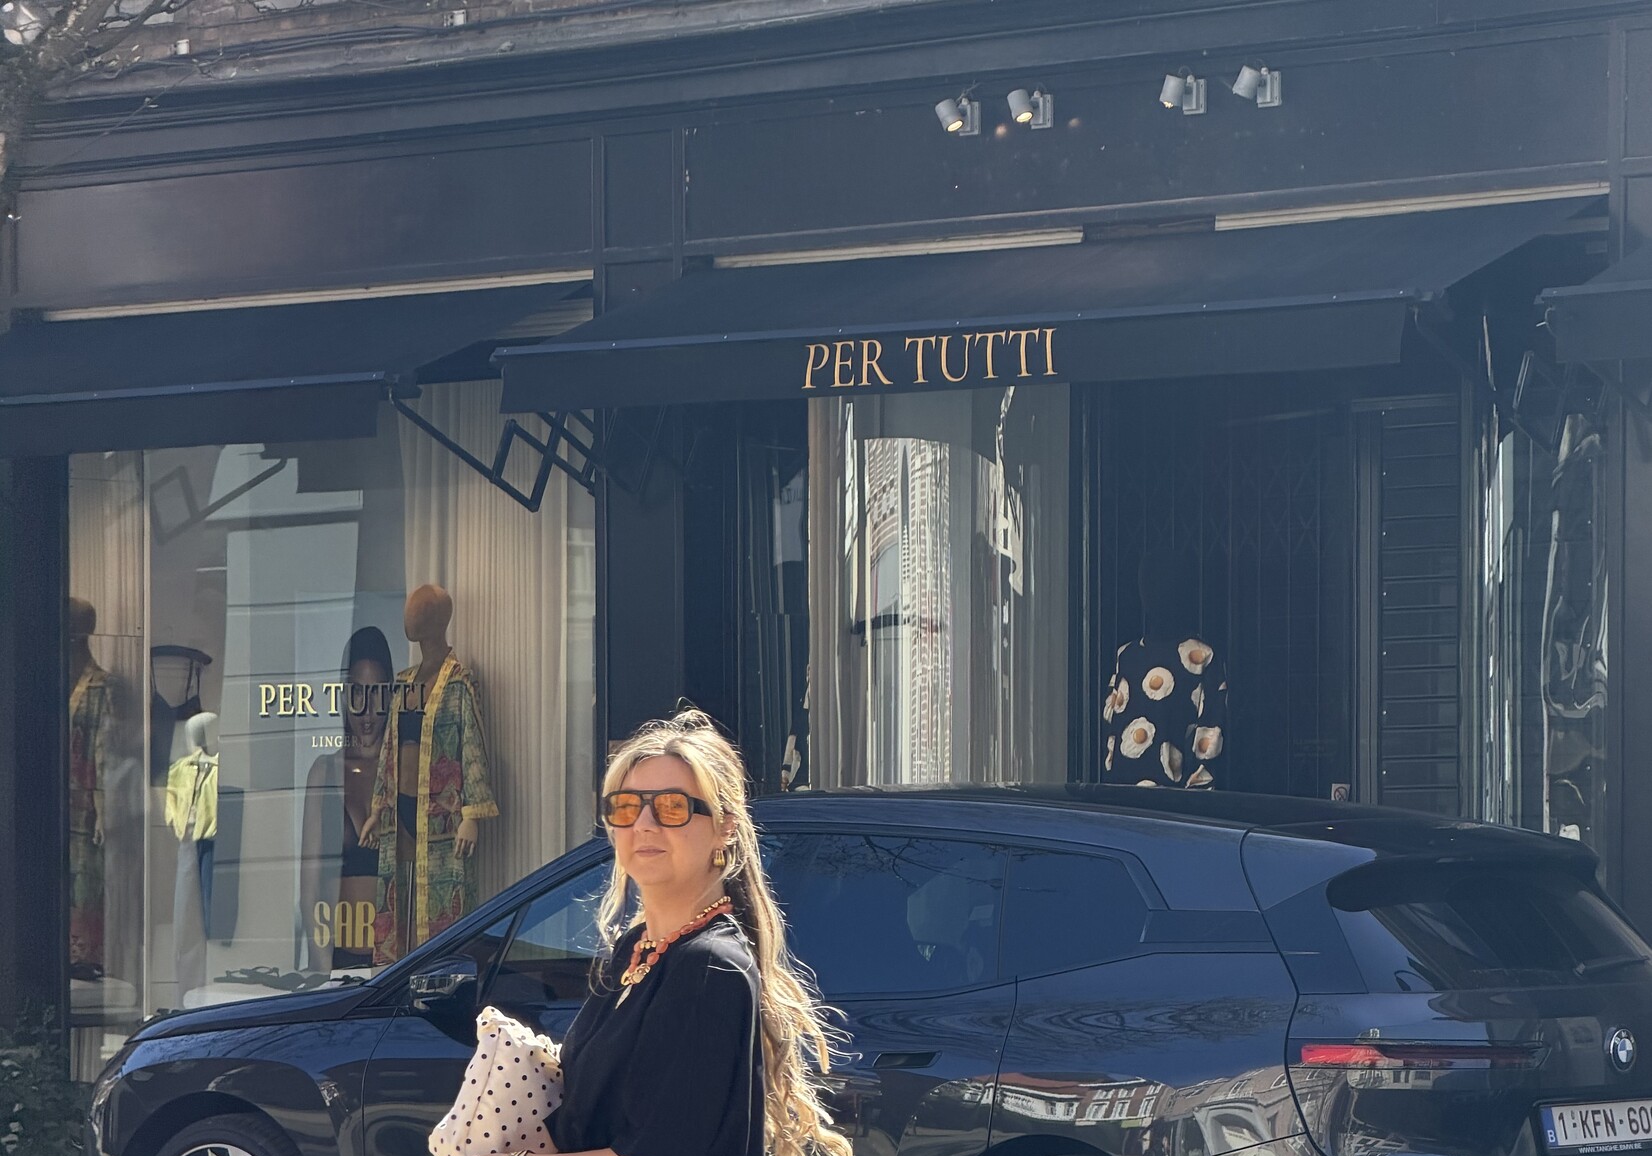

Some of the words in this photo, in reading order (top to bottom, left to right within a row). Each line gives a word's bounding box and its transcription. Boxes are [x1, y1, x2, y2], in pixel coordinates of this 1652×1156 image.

[802, 338, 893, 389] PER
[904, 328, 1057, 384] TUTTI
[258, 683, 318, 717] PER
[322, 683, 426, 716] TUTTI
[1547, 1129, 1556, 1143] B
